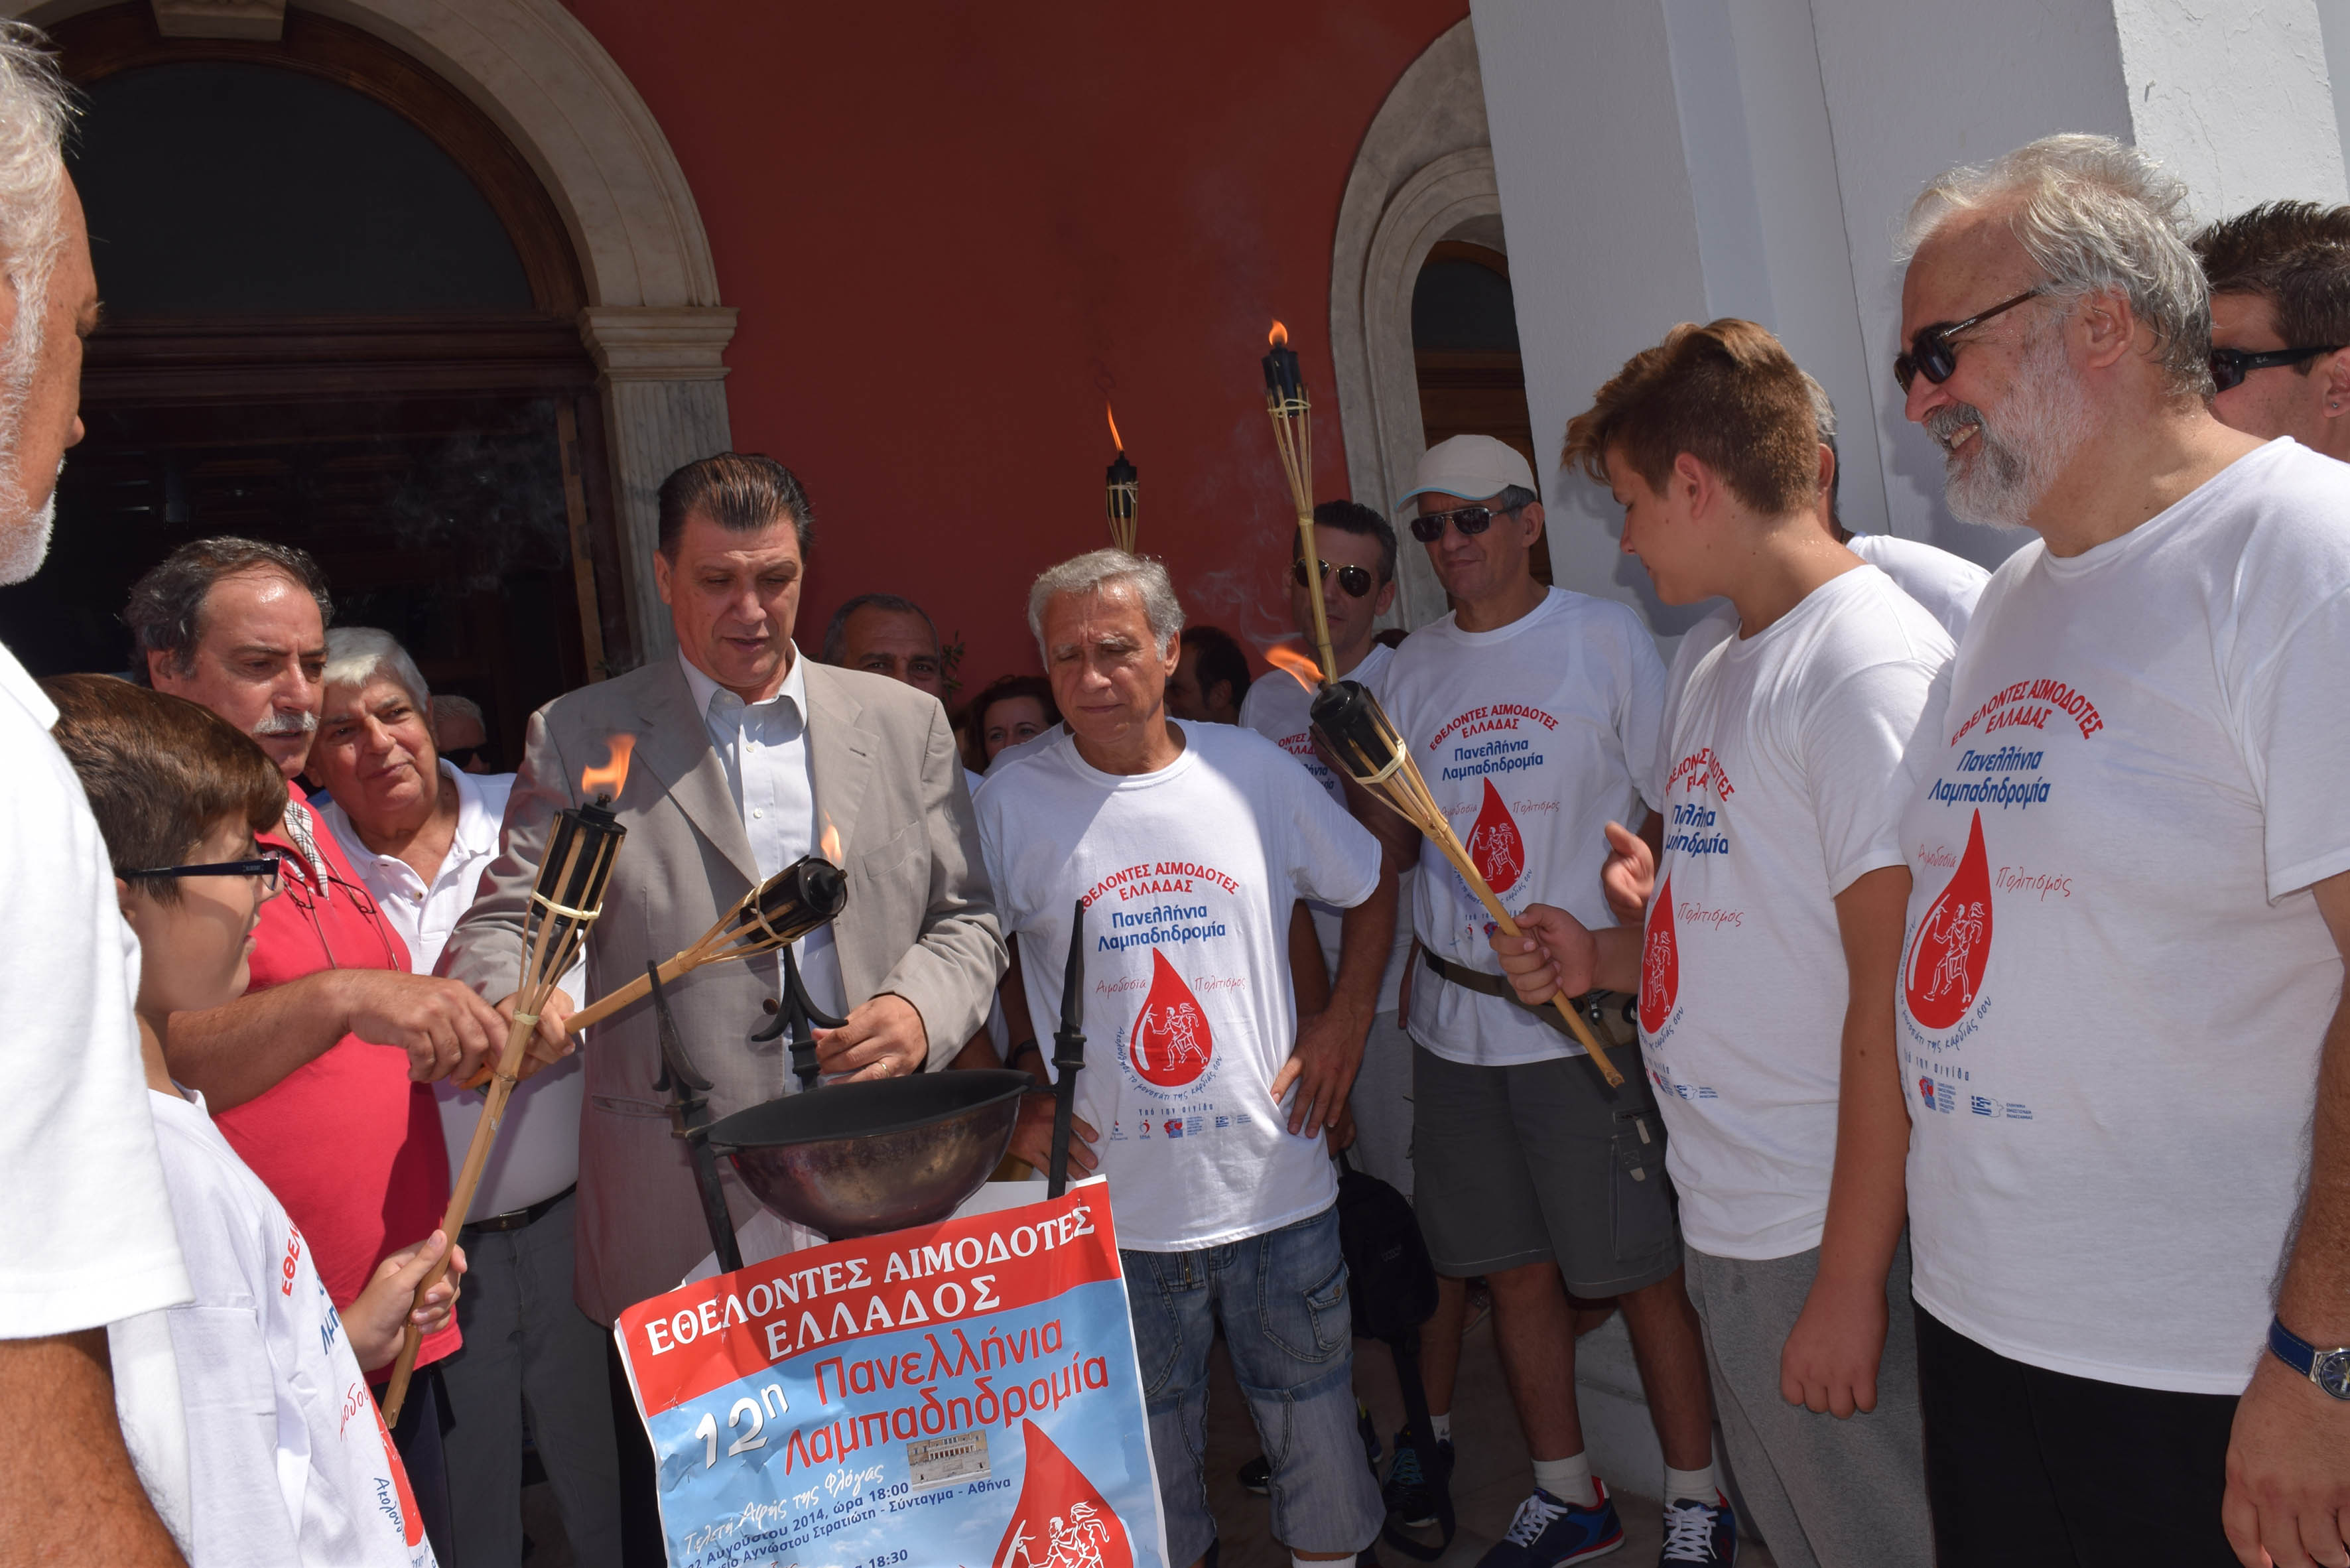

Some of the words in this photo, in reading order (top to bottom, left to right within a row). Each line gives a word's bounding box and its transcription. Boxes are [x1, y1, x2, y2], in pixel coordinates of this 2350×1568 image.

[1430, 706, 1489, 751] ΕΘΕΛΟΝΤΕΣ
[1491, 704, 1559, 730] ΑΙΜΟΔΟΤΕΣ
[1462, 719, 1519, 739] ΕΛΛΑΔΑΣ
[1951, 681, 2030, 748] ΕΘΕΛΟΝΤΕΣ
[2027, 679, 2104, 740] ΑΙΜΟΔΟΤΕΣ
[1985, 705, 2053, 734] ΕΛΛΑΔΑΣ
[1278, 733, 1307, 748] ΟΝΤΕΣ
[1455, 740, 1529, 762] Πανελλήνια
[1442, 753, 1543, 781] Λαμπαδηδρομία
[1957, 746, 2044, 771] Πανελλήνια
[1513, 800, 1560, 815] Πολιτισμός
[1928, 776, 2051, 810] Λαμπαδηδρομία
[1082, 864, 1151, 915] ΘΕΛΟΝΤΕΣ
[1155, 862, 1240, 895] ΑΙΜΟΔΟΤΕΣ
[1119, 879, 1193, 901] ΕΛΛΑΔΑΣ
[1995, 866, 2072, 902] Πολιτισμός
[1112, 905, 1208, 929] Πανελλήνια
[1678, 902, 1744, 931] Πολιτισμός
[1098, 921, 1226, 952] Λαμπαδηδρομία
[1096, 976, 1147, 999] Αιμοδοσία
[1195, 975, 1246, 994] Πολιτισμός
[645, 1258, 872, 1356] ΕΘΕΛΟΝΤΕΣ
[883, 1205, 1095, 1283] ΑΙΜΟΔΟΤΕΣ
[764, 1274, 1000, 1360] ΕΛΛΑΔΟΣ
[814, 1317, 1063, 1406] Πανελλήνια
[695, 1383, 789, 1469] 12η
[785, 1353, 1108, 1476] Λαμπαδηδρομία
[684, 1518, 733, 1555] Τελετή
[738, 1498, 787, 1530] Αφής
[793, 1486, 819, 1509] της
[824, 1465, 884, 1498] Φλόγας
[706, 1526, 788, 1565] Αυγούστου
[793, 1508, 828, 1532] 2014,
[833, 1496, 863, 1514] ώρα
[869, 1482, 909, 1502] 18:00
[744, 1533, 809, 1563] Αγνώστου
[813, 1508, 876, 1539] Στρατιώτη
[889, 1490, 954, 1512] Σύνταγμα
[968, 1478, 1011, 1495] Αθήνα
[869, 1549, 908, 1568] 18:30
